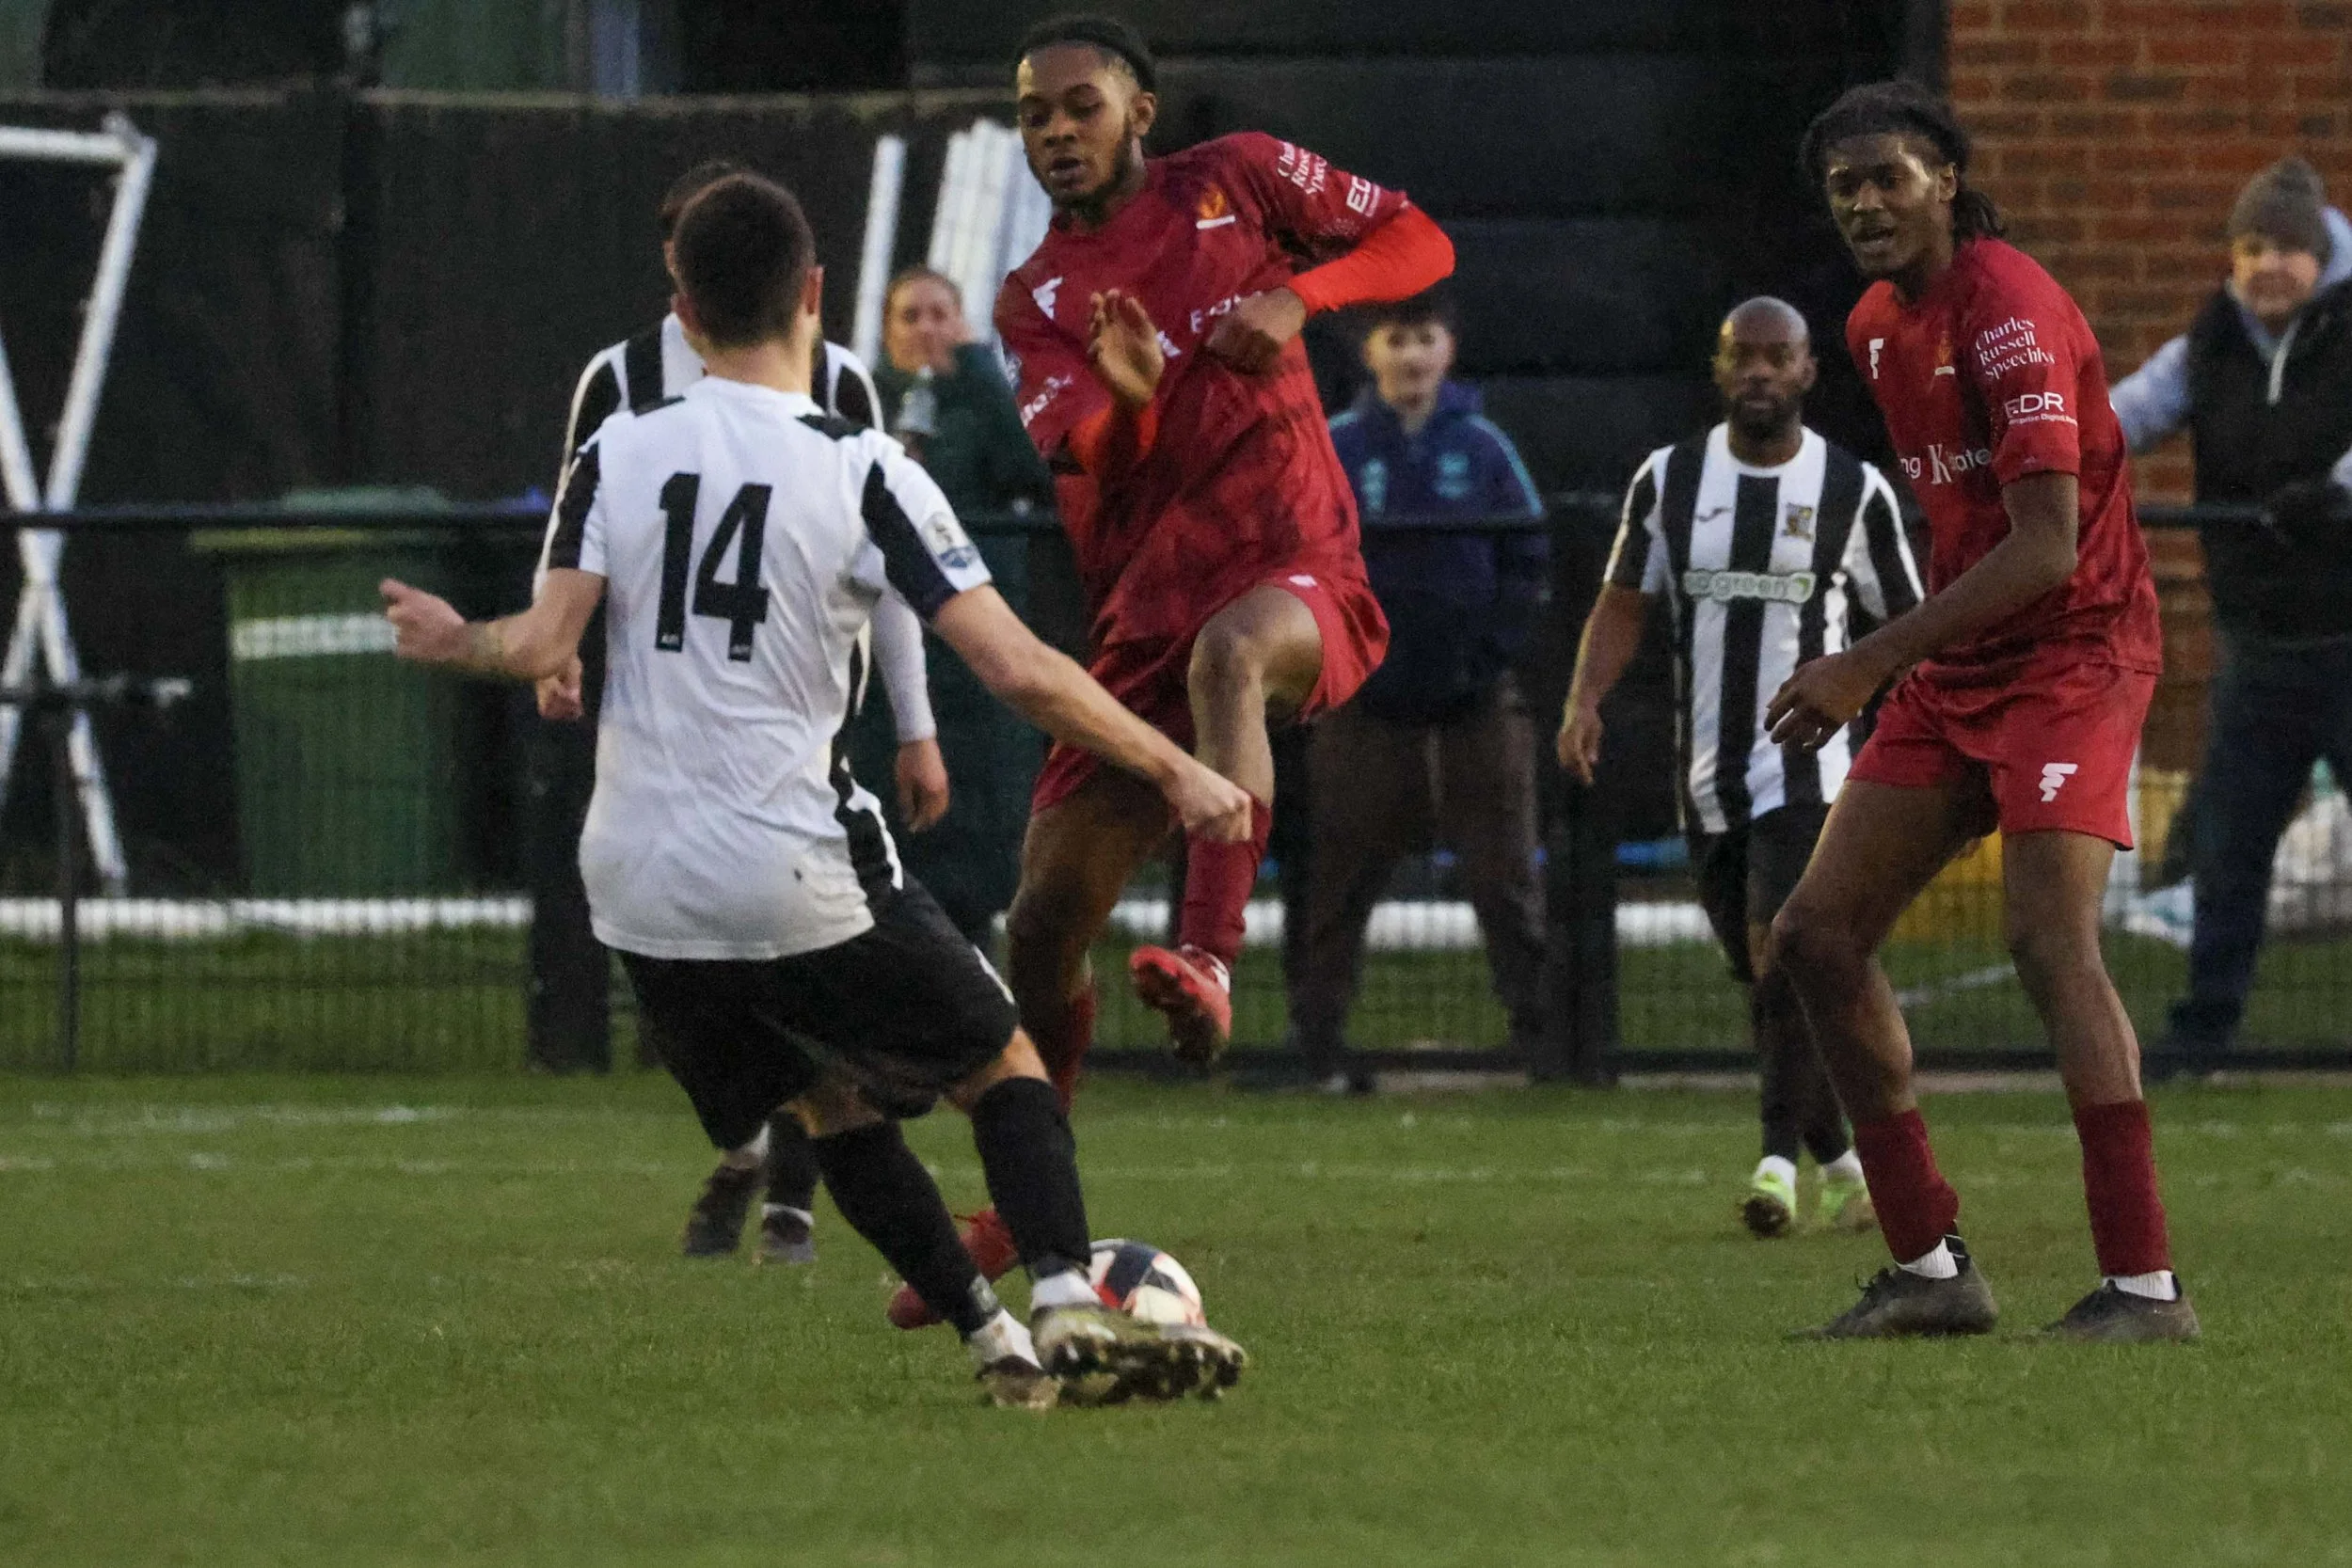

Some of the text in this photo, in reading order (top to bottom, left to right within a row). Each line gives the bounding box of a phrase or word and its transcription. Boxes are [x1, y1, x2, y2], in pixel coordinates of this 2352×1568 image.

[1977, 317, 2035, 350] Charles
[1979, 329, 2037, 367] Russell
[2005, 392, 2063, 418] EDR
[654, 471, 773, 663] 14
